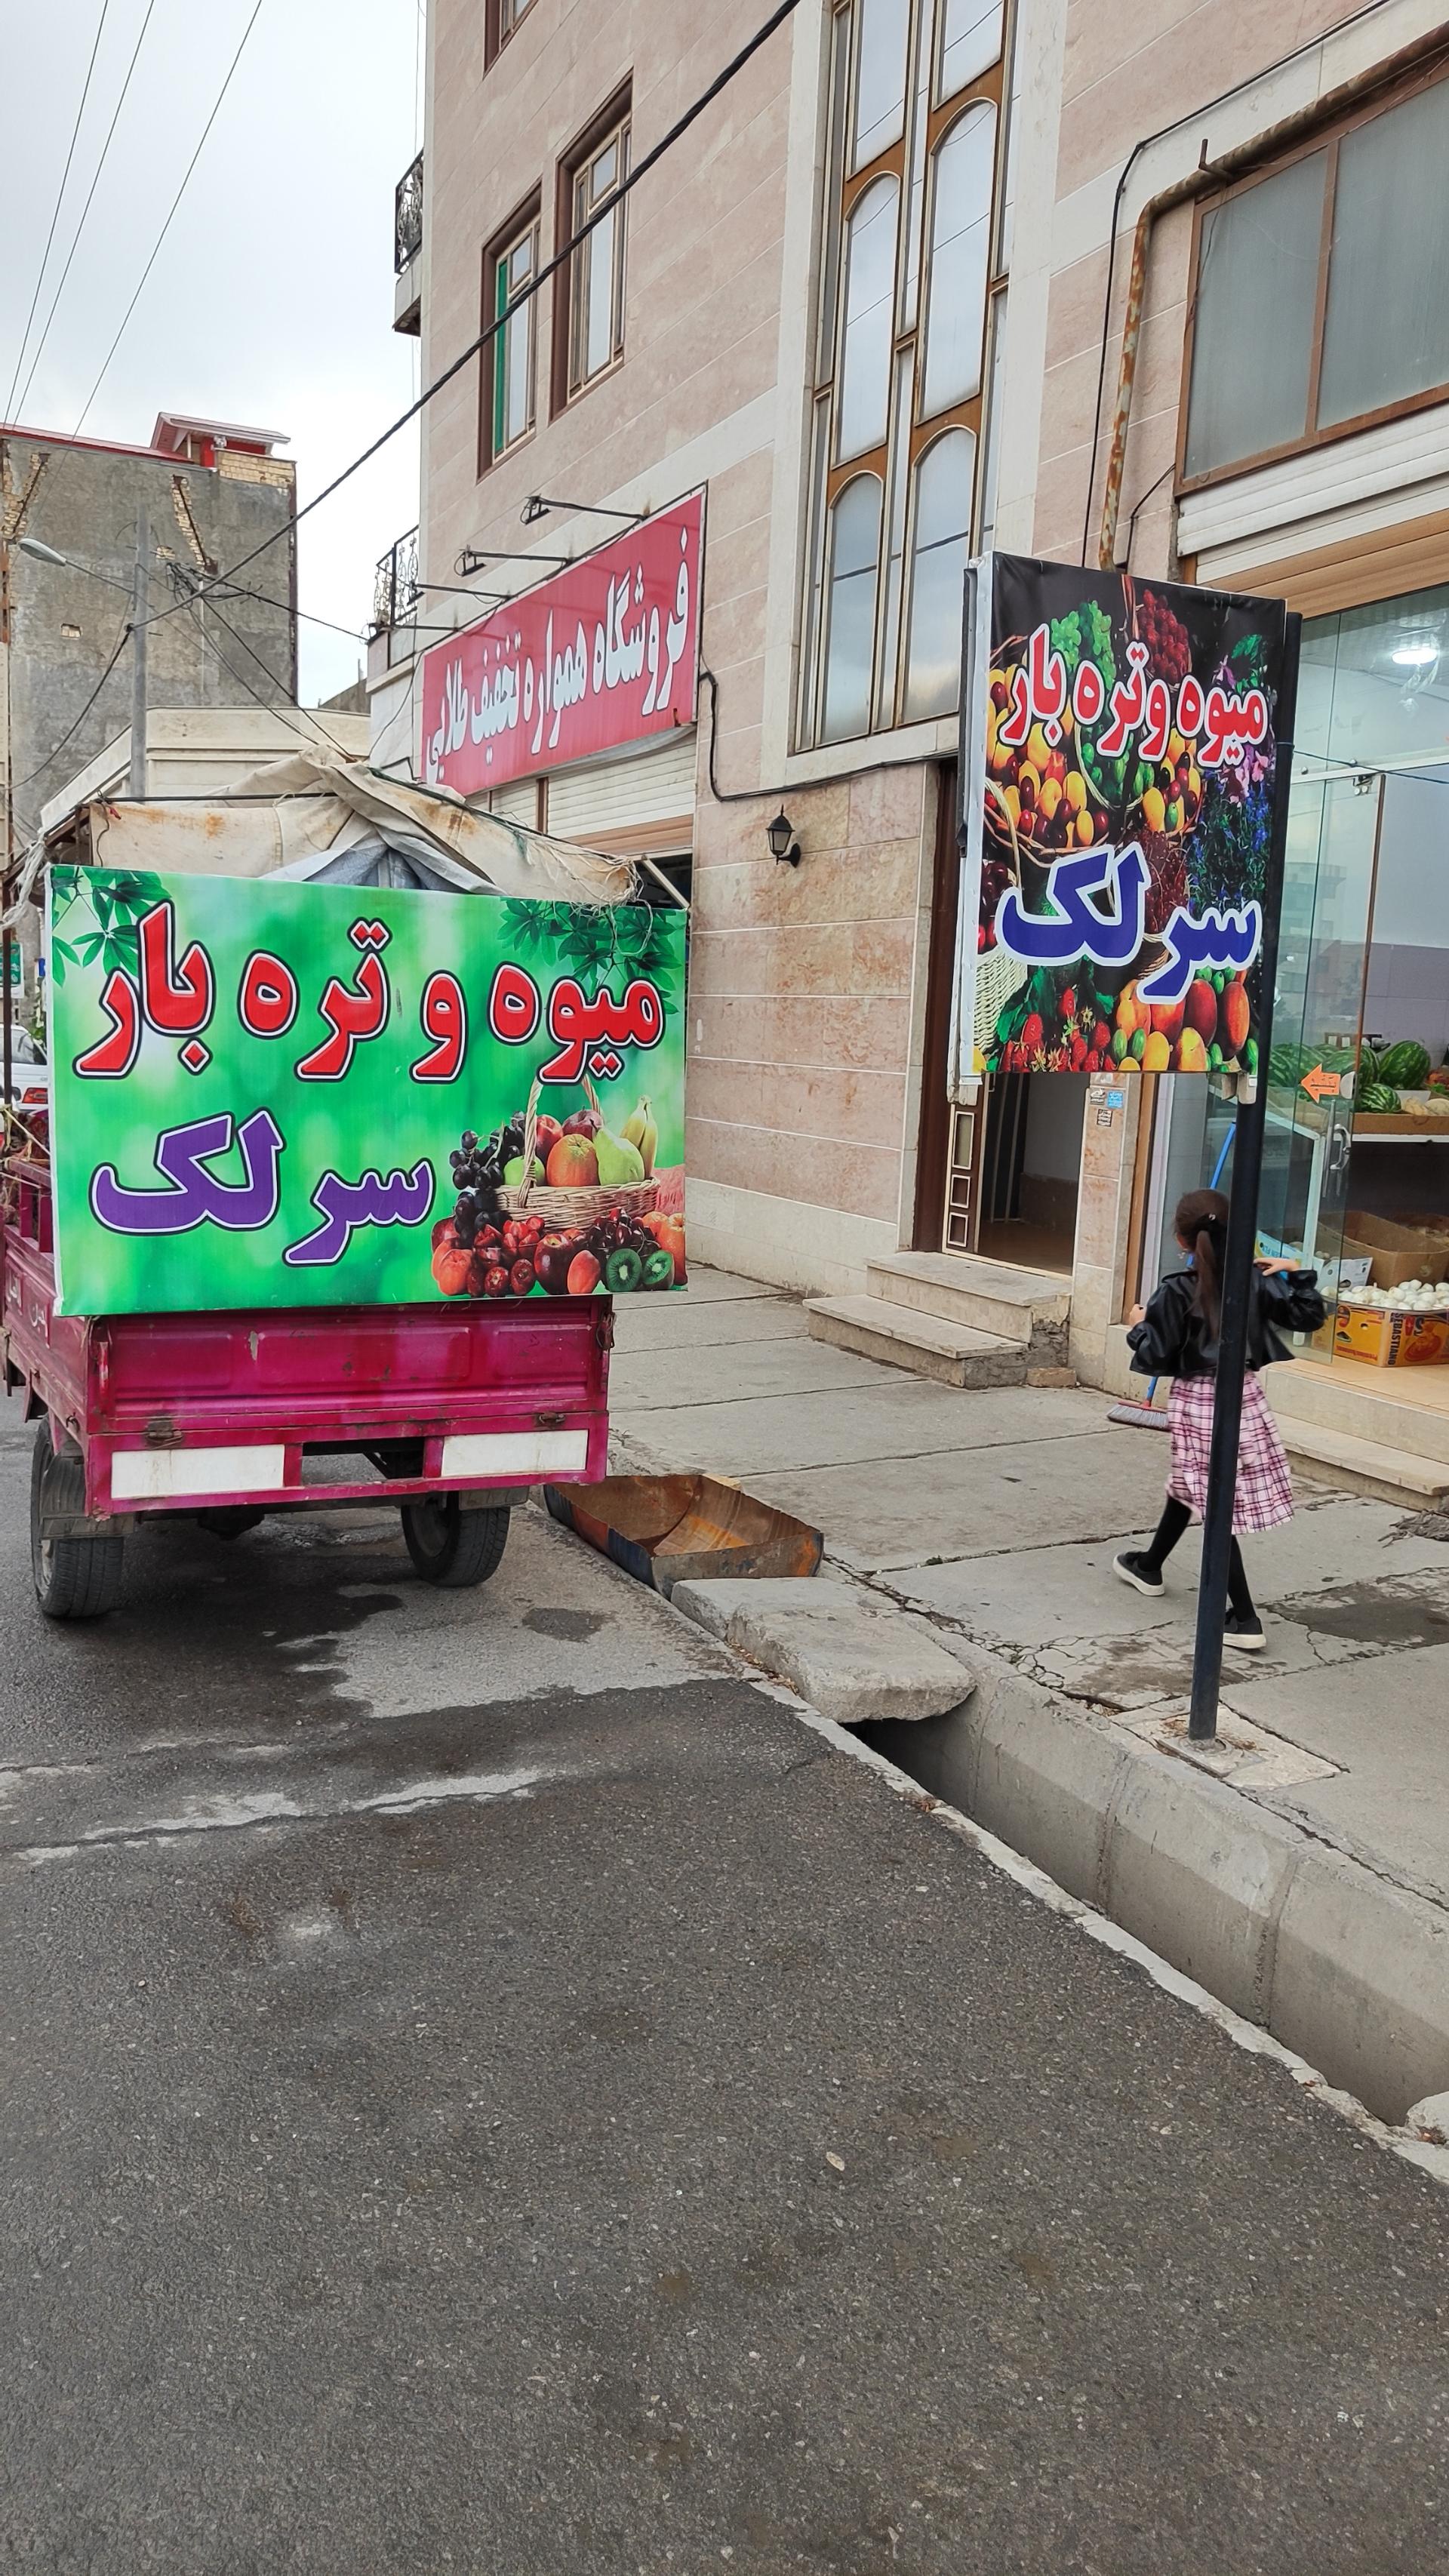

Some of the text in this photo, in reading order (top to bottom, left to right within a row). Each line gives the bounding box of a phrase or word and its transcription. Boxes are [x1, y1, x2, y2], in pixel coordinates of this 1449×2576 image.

[593, 525, 689, 716] فروشگاه
[999, 623, 1066, 746] بار
[471, 631, 522, 765] تخفیف
[1177, 673, 1269, 768] میوه
[74, 900, 665, 1085] میوه و تره بار
[1388, 1313, 1403, 1365] SEBASTIANO
